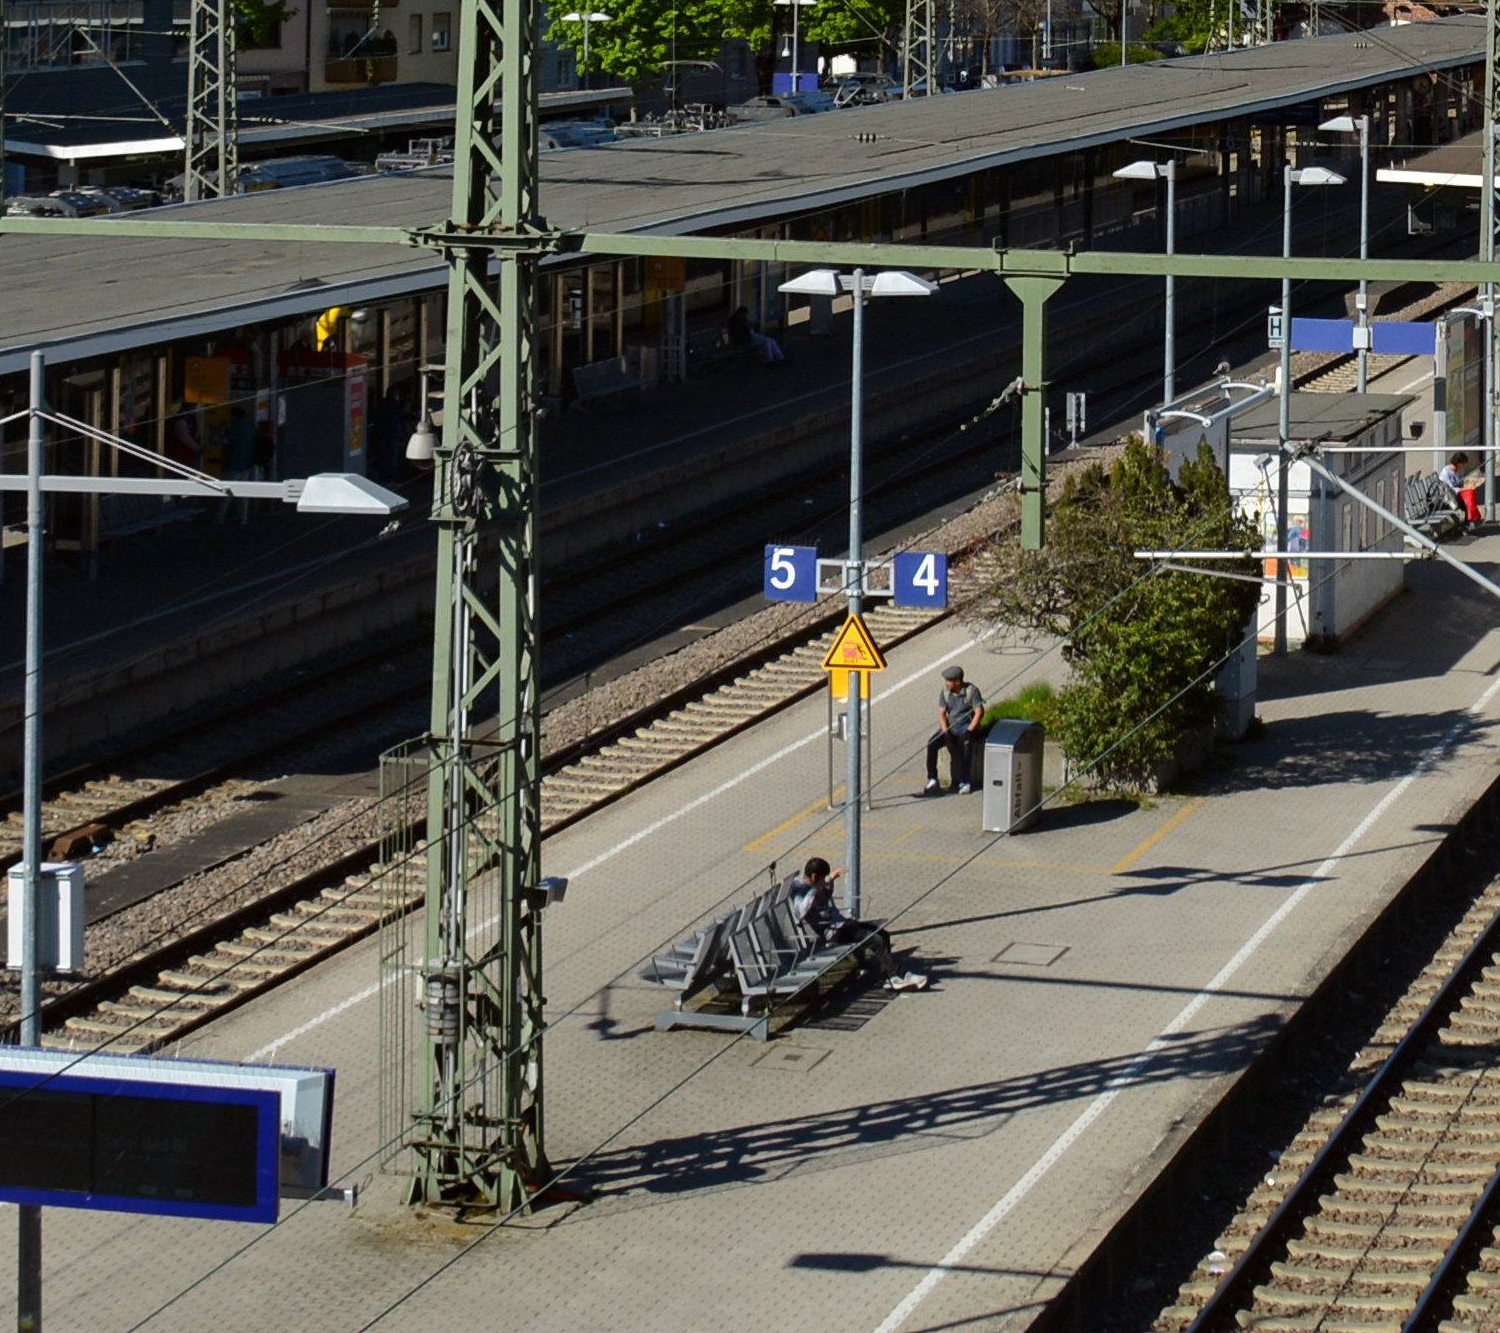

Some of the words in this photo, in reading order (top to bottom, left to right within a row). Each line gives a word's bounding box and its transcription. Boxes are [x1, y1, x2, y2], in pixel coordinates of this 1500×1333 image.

[959, 70, 968, 84] 8
[1270, 317, 1283, 337] H
[770, 548, 796, 590] 5
[912, 554, 940, 596] 4
[1013, 772, 1023, 818] Abfall
